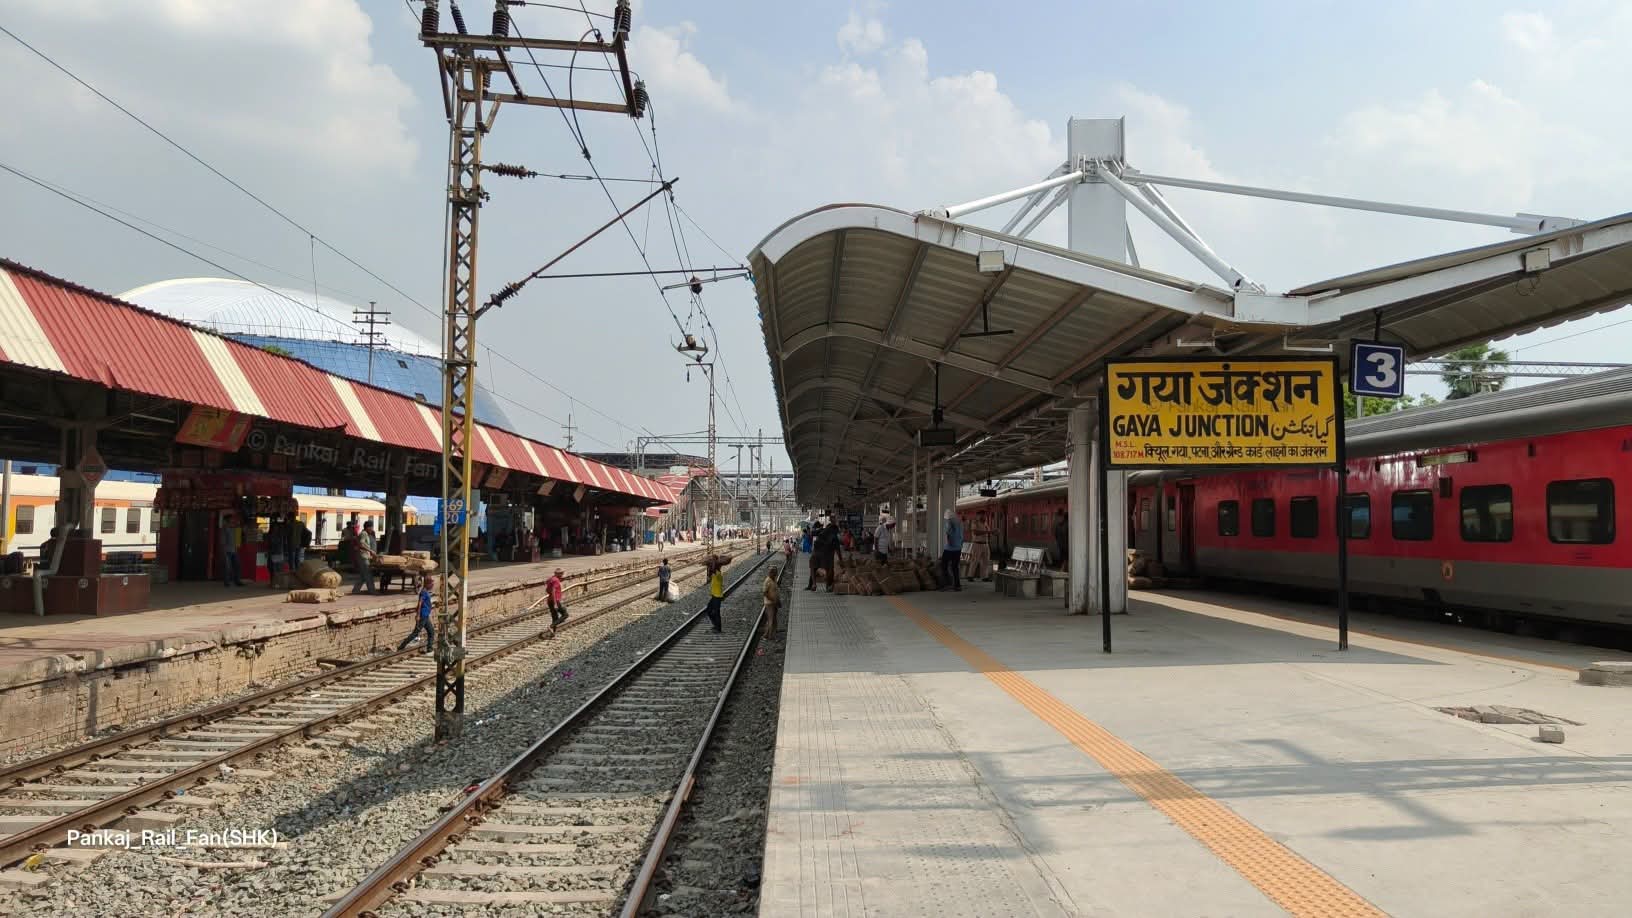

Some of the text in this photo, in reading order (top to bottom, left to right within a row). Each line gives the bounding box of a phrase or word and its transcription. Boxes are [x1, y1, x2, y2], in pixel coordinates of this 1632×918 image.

[1116, 362, 1323, 412] गया जंक्शन
[1365, 351, 1398, 389] 3
[1113, 414, 1269, 437] GAYA JUNCTION
